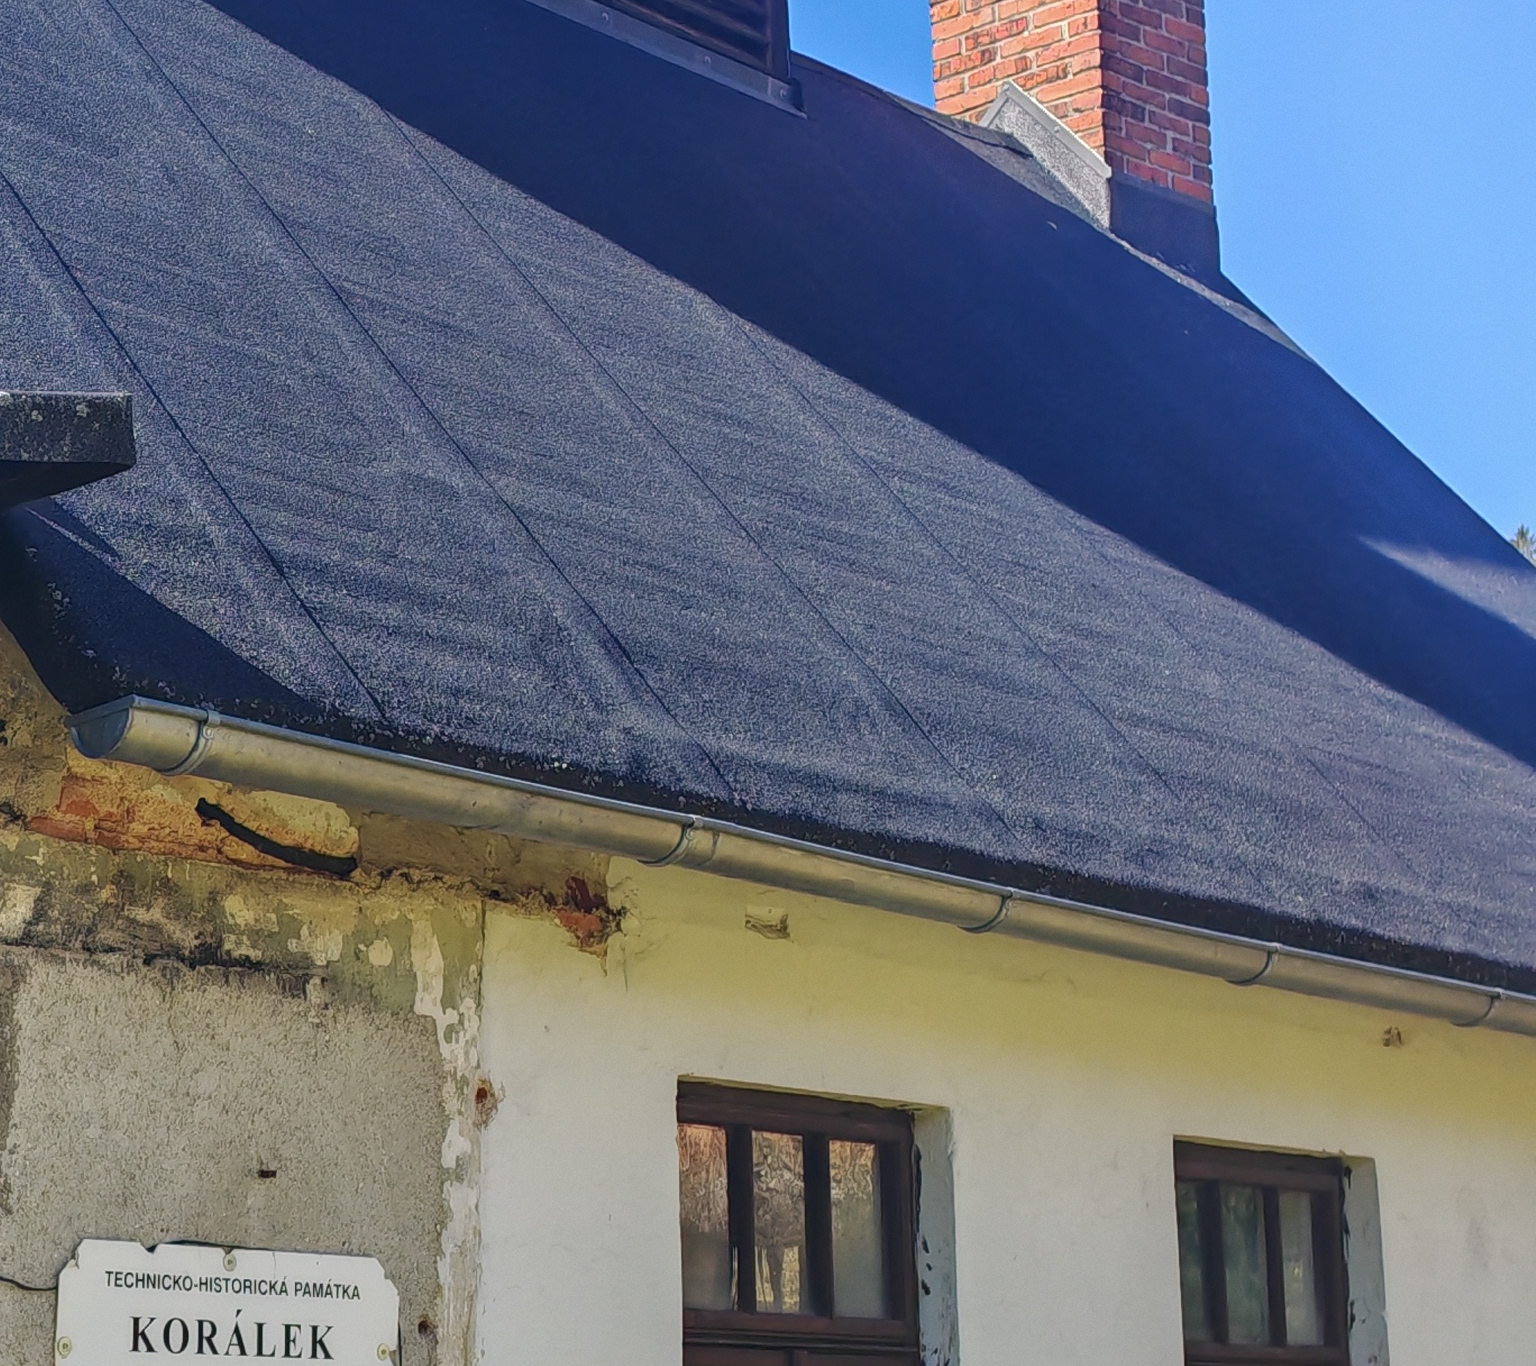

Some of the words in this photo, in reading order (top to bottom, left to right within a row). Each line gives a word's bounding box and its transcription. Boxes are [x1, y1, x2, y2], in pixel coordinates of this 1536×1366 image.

[104, 1269, 289, 1297] TECHNICKO-HISTORICKÁ
[294, 1278, 361, 1300] PAMÁTKA
[129, 1308, 335, 1361] KORÁLEK
